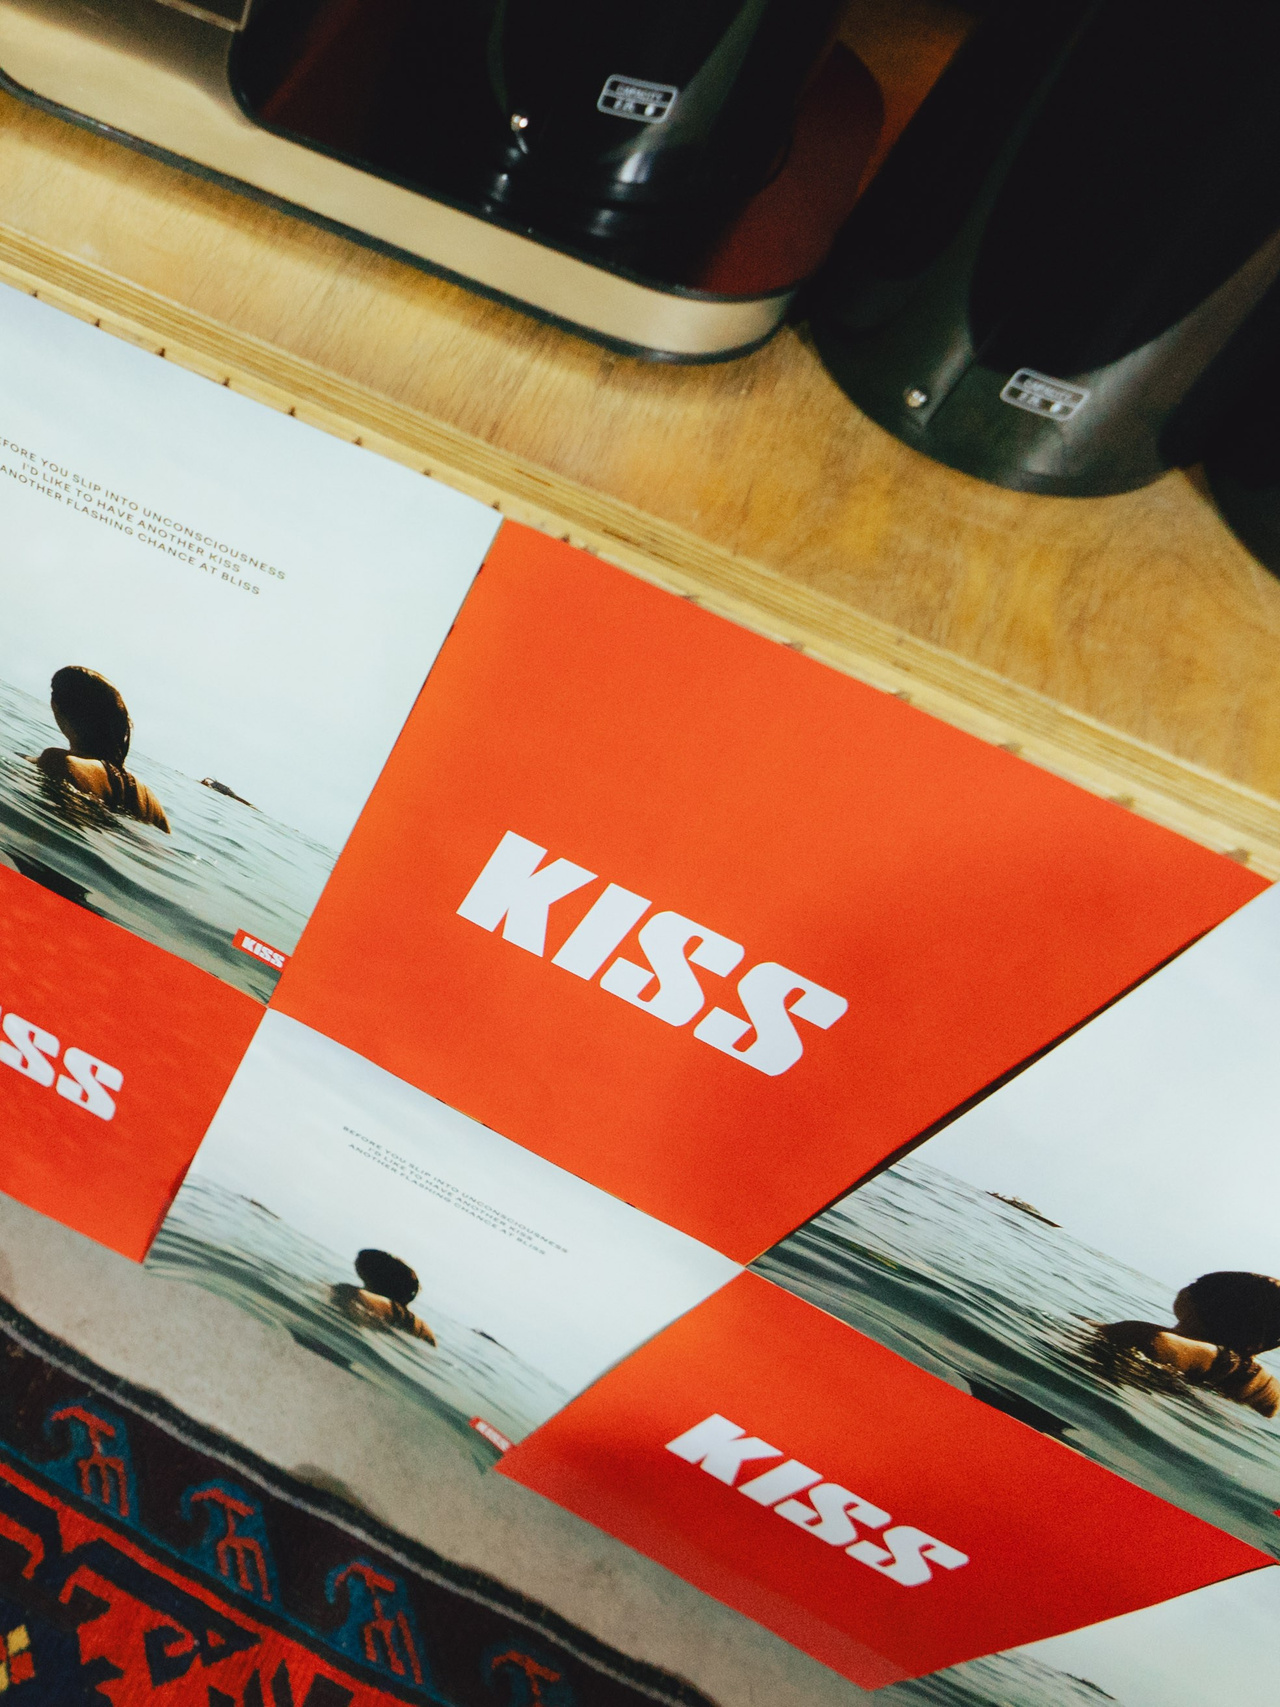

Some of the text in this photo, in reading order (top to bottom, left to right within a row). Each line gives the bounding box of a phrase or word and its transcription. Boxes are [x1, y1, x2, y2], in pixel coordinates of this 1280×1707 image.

[0, 465, 260, 595] ANOTHER FLASHING CHANCE AT BLISS
[22, 463, 241, 573] I'D LIKE TO HAVE ANOTHER KISS
[41, 458, 68, 477] YOU
[73, 474, 101, 492] SLIP
[105, 490, 138, 511] INTO
[143, 508, 286, 580] UNCONSCIOUSNESS
[241, 936, 285, 968] KISS
[456, 830, 848, 1076] KISS
[343, 1126, 382, 1149] BEFORE
[385, 1149, 406, 1163] YOU
[434, 1177, 459, 1193] INTO
[665, 1413, 969, 1587] KISS
